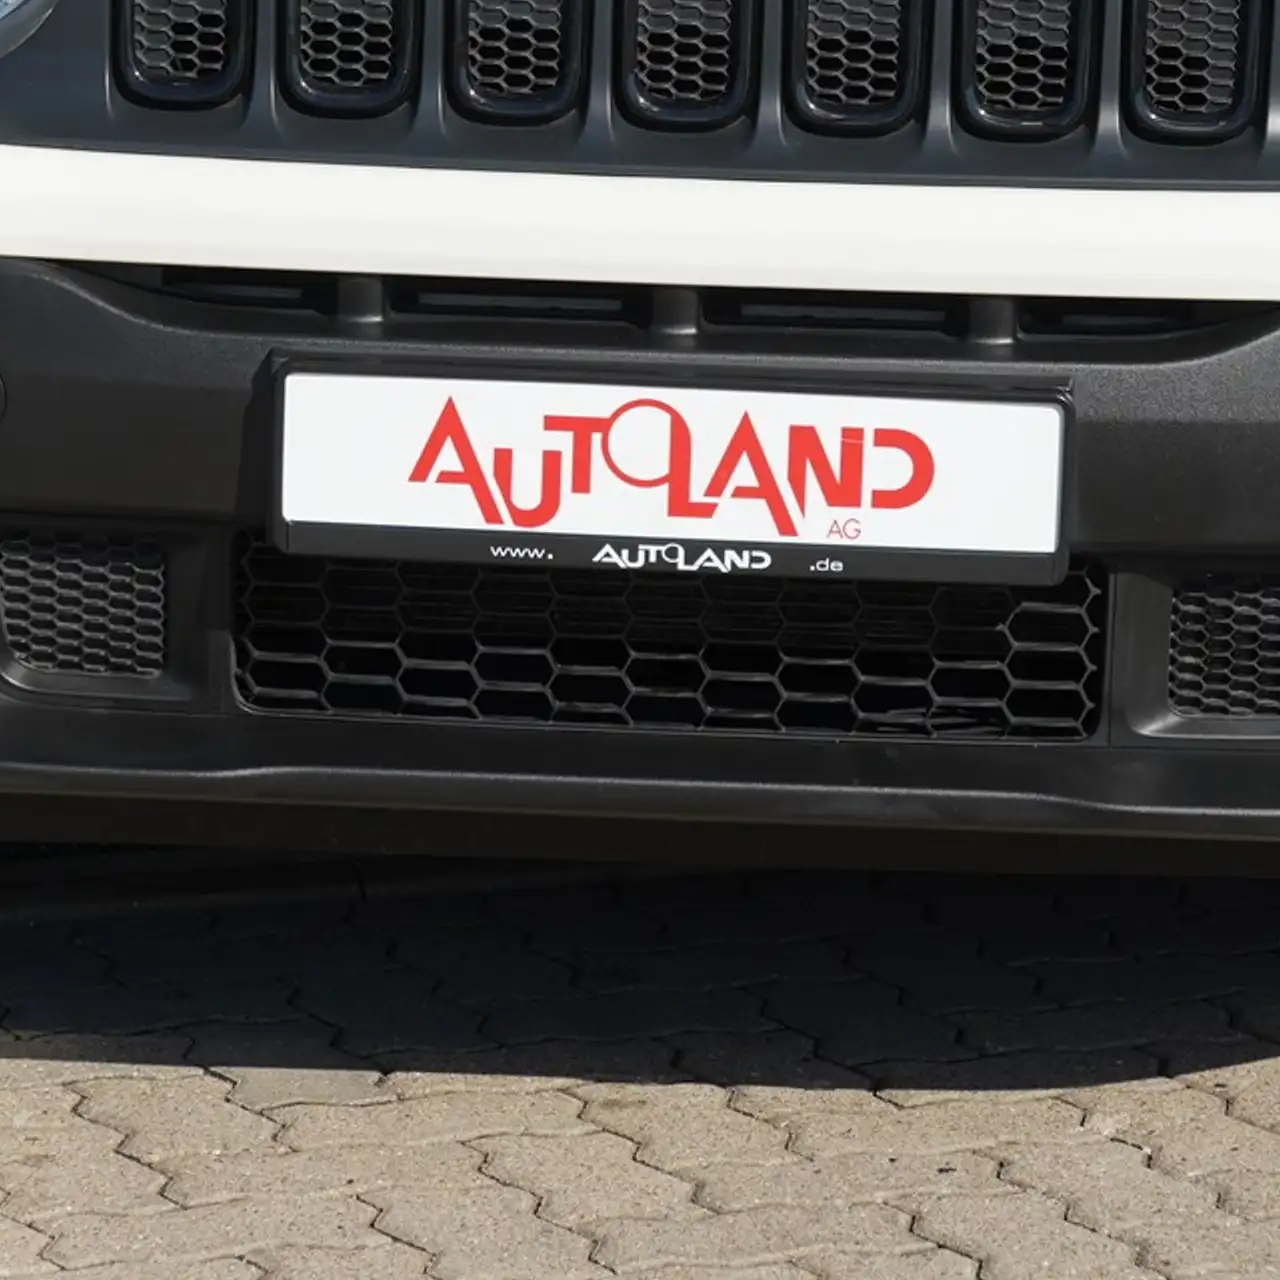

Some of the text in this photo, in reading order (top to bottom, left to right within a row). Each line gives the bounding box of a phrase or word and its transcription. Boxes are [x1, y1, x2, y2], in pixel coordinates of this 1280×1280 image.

[408, 396, 935, 538] AUTOLAND
[826, 519, 862, 540] AG
[490, 543, 844, 572] www. AUTOLAND .de
